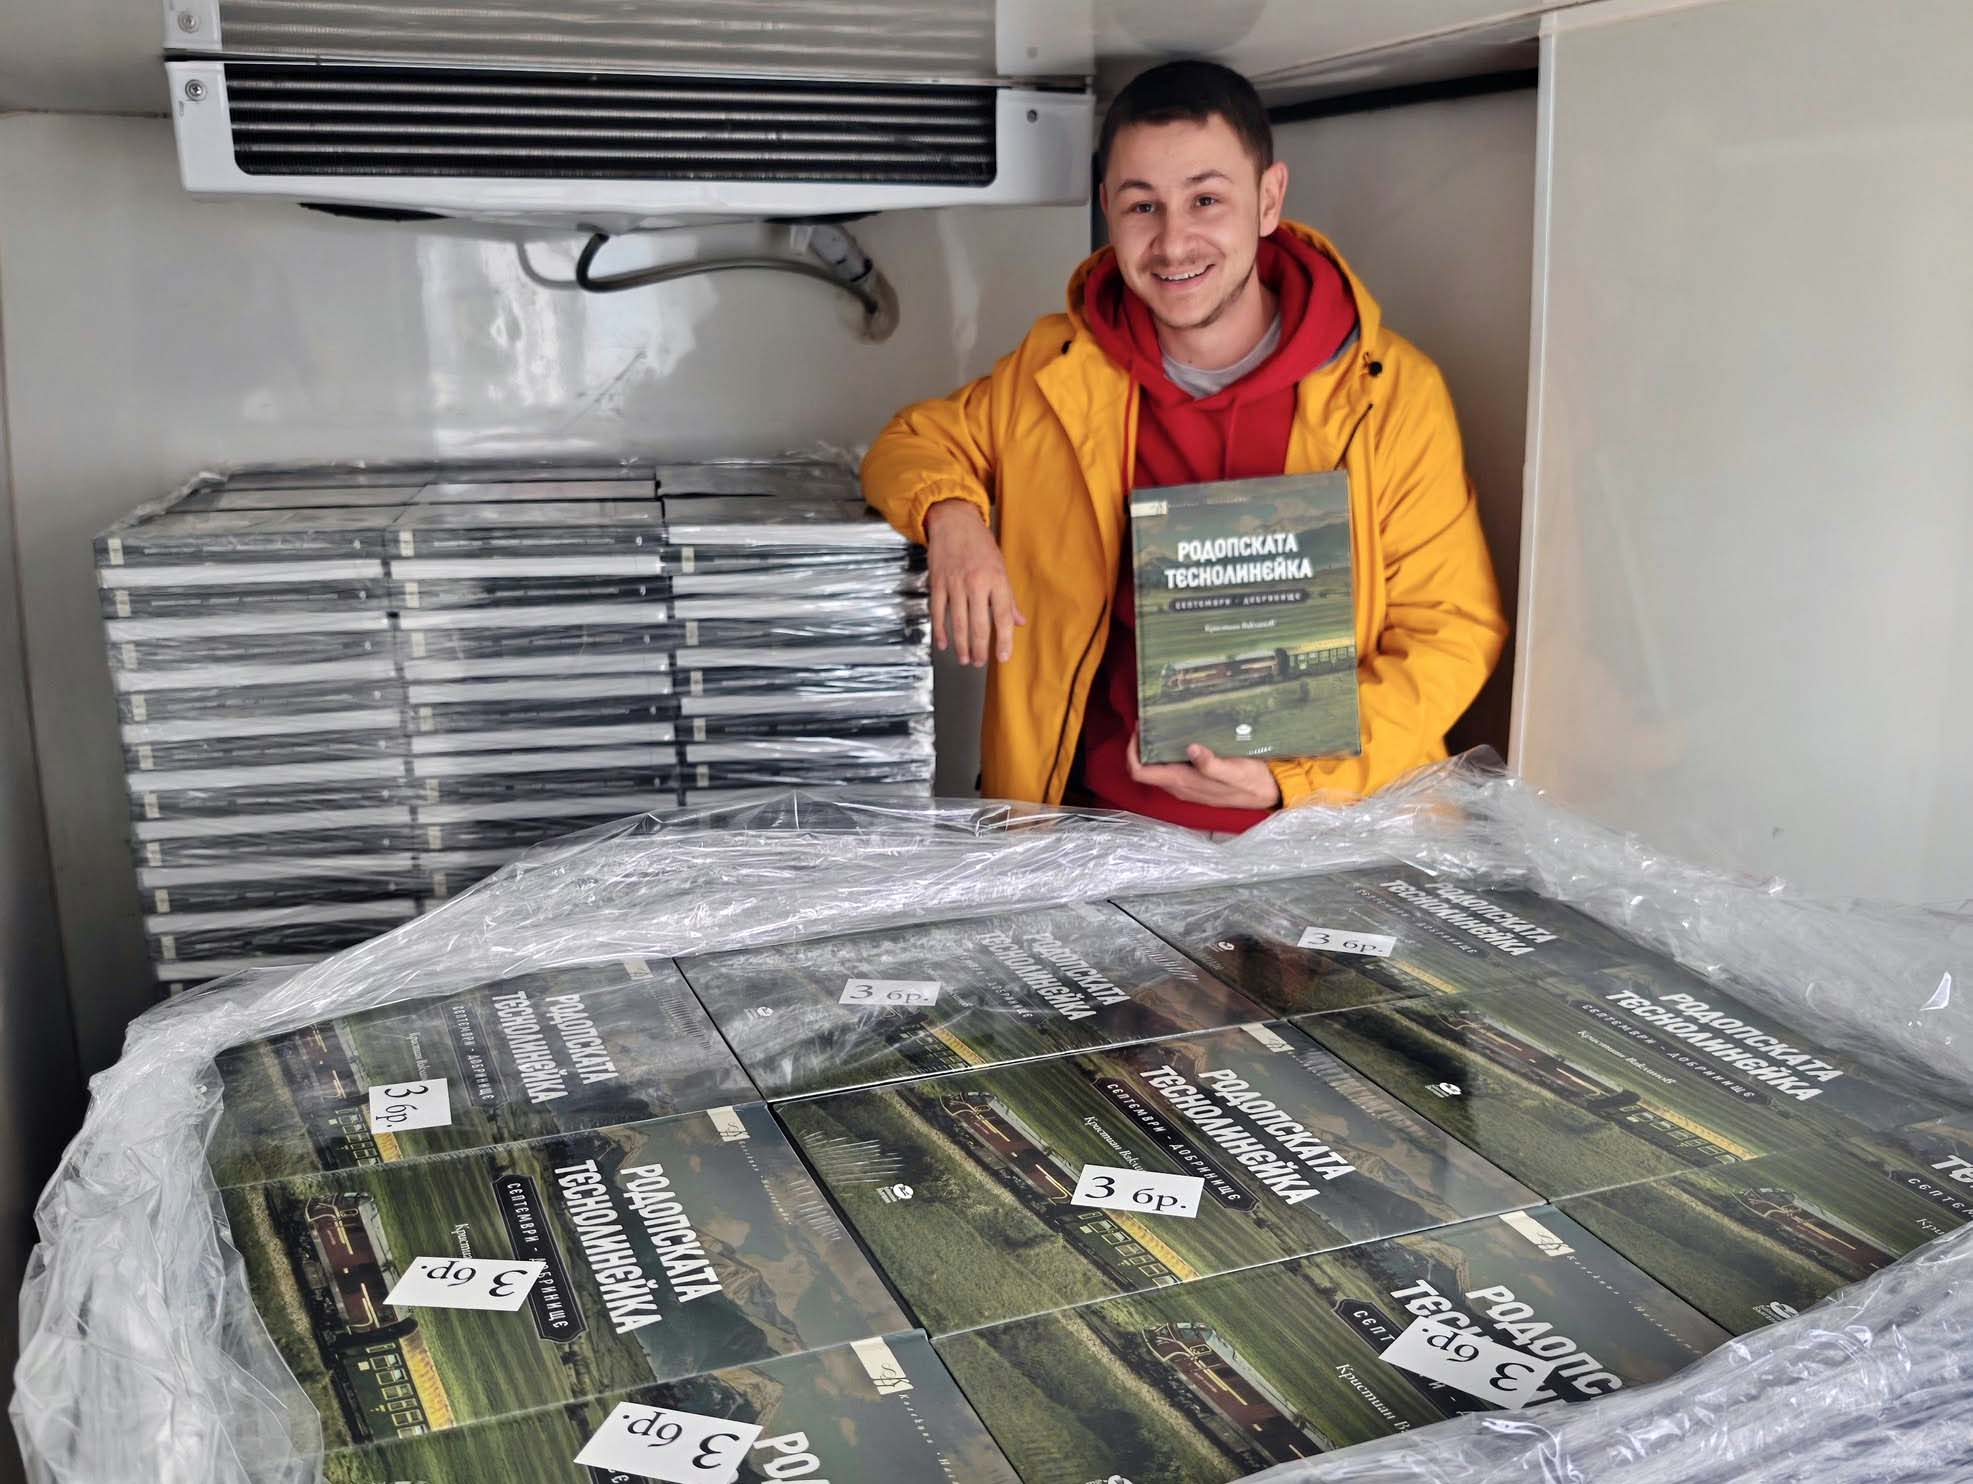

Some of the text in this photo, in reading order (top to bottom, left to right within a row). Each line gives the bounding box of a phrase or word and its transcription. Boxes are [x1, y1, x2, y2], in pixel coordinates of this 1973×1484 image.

[1164, 558, 1313, 588] ТЕСНОЛИНЕЙКА
[1178, 533, 1298, 562] РОДОПСКАТА
[1307, 932, 1384, 954] 3 бр.
[1380, 879, 1536, 957] ТЕСНОЛИНЕЙКА
[1424, 881, 1559, 944] РОДОПСКАТА
[850, 984, 929, 1004] 3 бр.
[976, 931, 1097, 1021] ТЕСНОЛИНЕЙКА
[1024, 932, 1131, 1006] РОДОПСКАТА
[492, 991, 569, 1104] ТЕСНОЛИНЕЙКА
[545, 993, 619, 1085] РОДОПСКАТА
[1605, 990, 1824, 1101] ТЕСНОЛИНЕЙКА
[1658, 992, 1844, 1082] РОДОПСКАТА
[374, 1084, 429, 1129] 3 бр.
[1107, 1083, 1241, 1201] СЕПТЕМВРИ ДОБРИНИЩЕ
[1139, 1064, 1322, 1205] ТЕСНОЛИНЕЙКА
[1198, 1068, 1356, 1181] РОДОПСКАТА
[506, 1182, 541, 1244] СЕПТЕМВРИ
[1084, 1176, 1187, 1211] 3 бр.
[554, 1158, 664, 1335] ТЕСНОЛИНЕЙКА
[619, 1163, 723, 1303] РОДОПСКАТА
[421, 1260, 528, 1298] 3 бр.
[1422, 1328, 1535, 1392] 3 бр.
[1465, 1285, 1623, 1398] РОДОПС
[1336, 1364, 1396, 1420] Кристиан
[622, 1411, 741, 1470] 3 бр.
